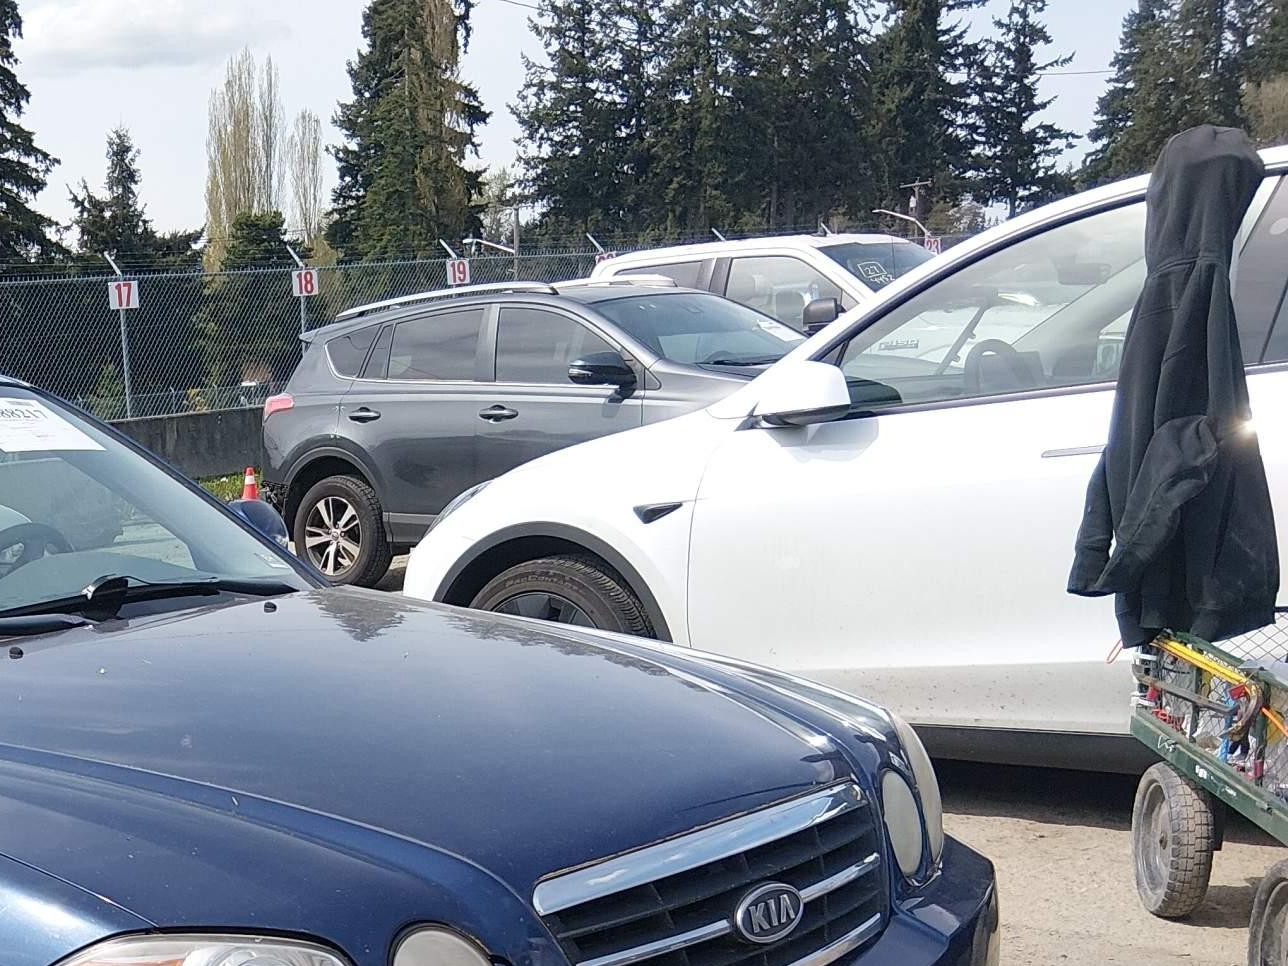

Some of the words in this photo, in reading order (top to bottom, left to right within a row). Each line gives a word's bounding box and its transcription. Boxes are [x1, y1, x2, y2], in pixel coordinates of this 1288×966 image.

[296, 270, 315, 295] 18
[450, 260, 467, 284] 19
[863, 265, 880, 275] 27
[114, 282, 132, 307] 17
[748, 893, 796, 934] KIA
